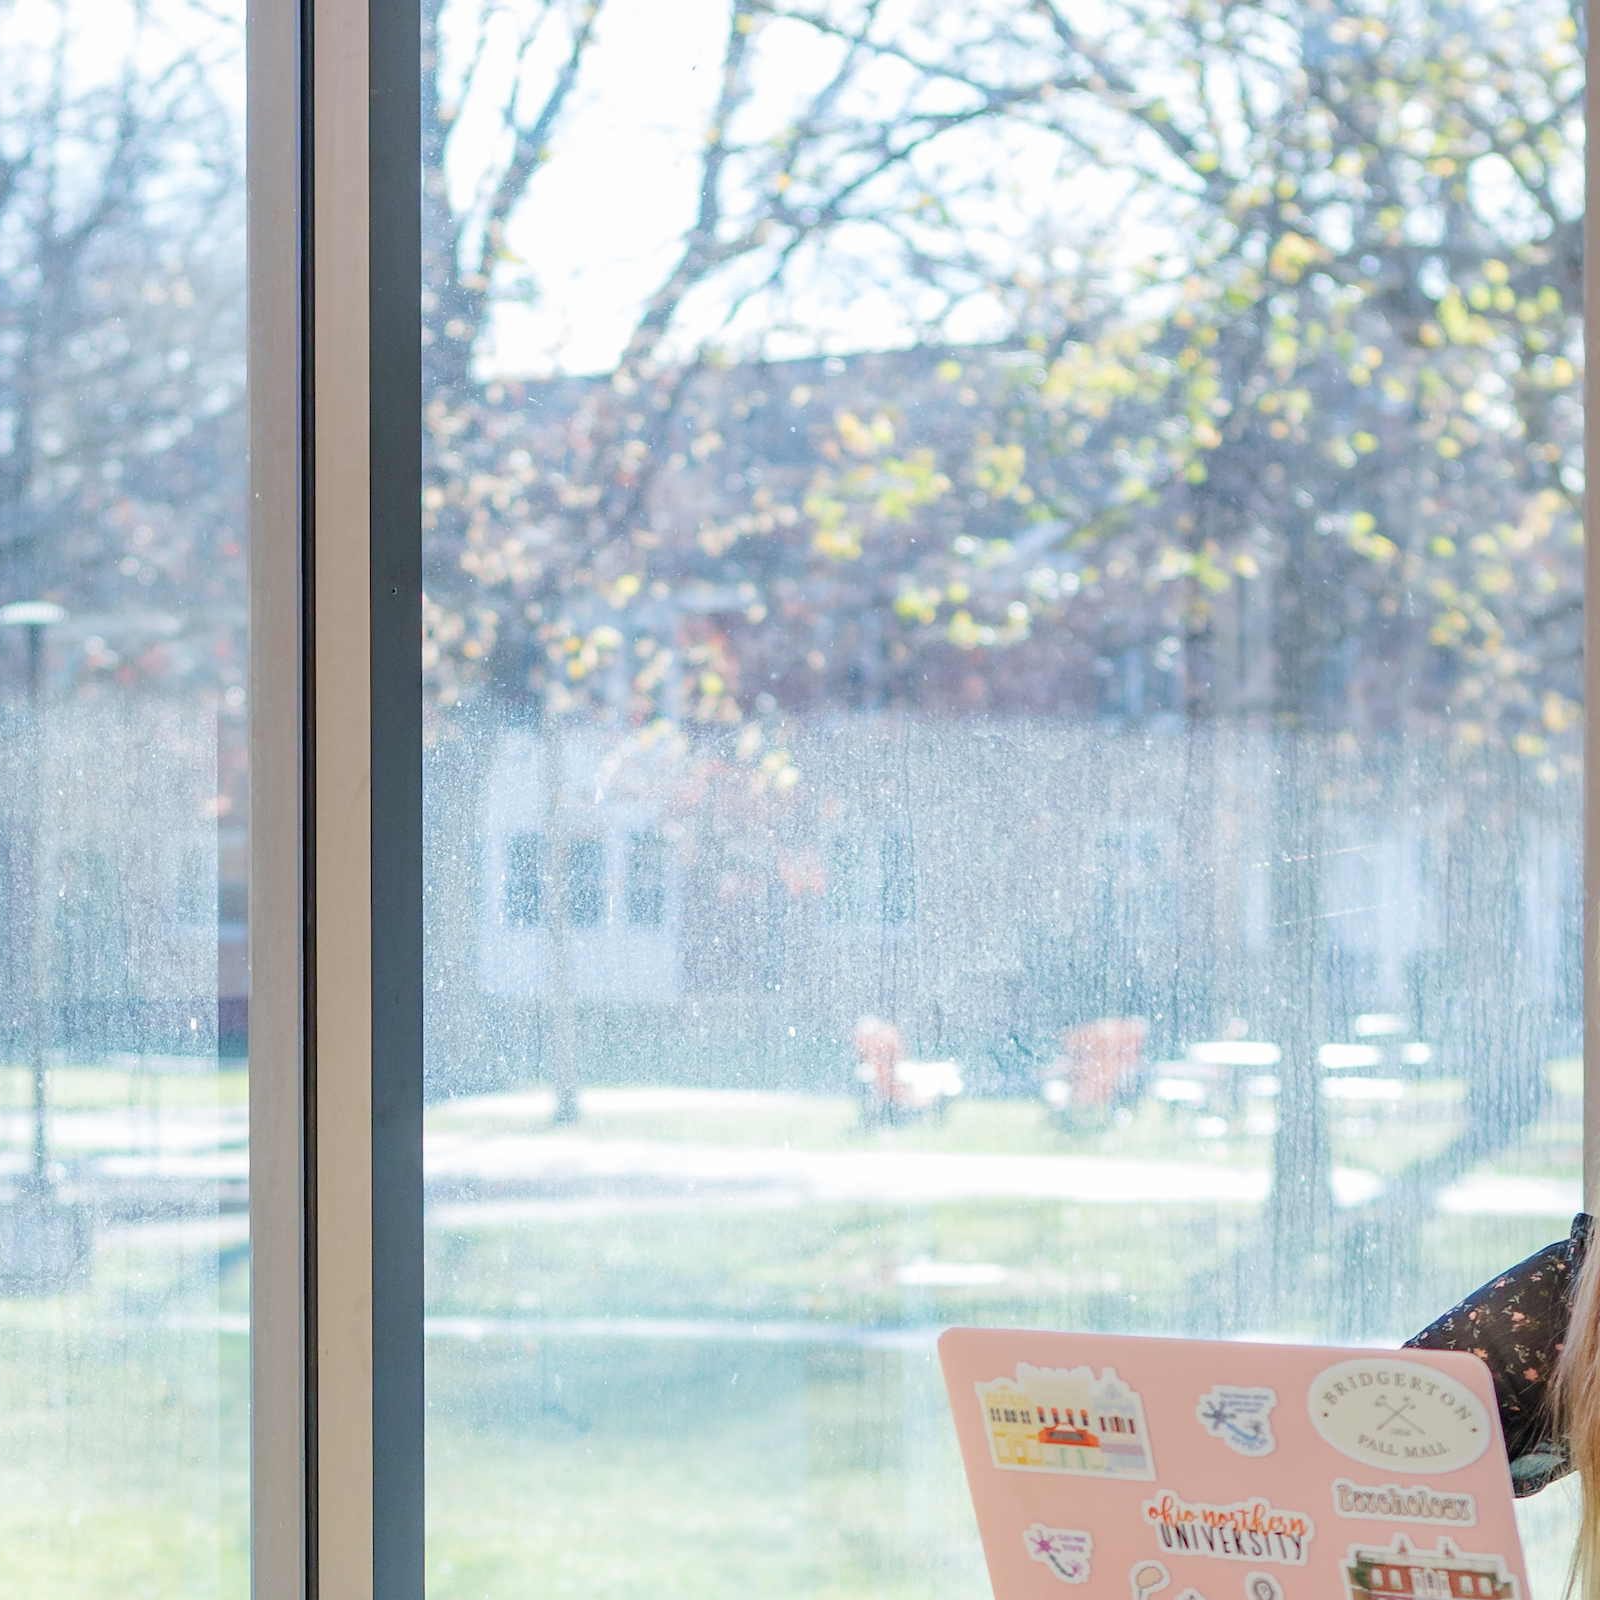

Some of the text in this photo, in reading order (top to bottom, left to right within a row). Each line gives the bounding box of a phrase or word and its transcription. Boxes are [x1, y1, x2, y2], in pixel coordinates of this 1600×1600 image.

[1322, 1371, 1473, 1421] BRIDGERTON
[1357, 1433, 1451, 1459] PALL MALL
[1148, 1495, 1309, 1537] ohio northern
[1159, 1522, 1302, 1560] UNIVERSITY
